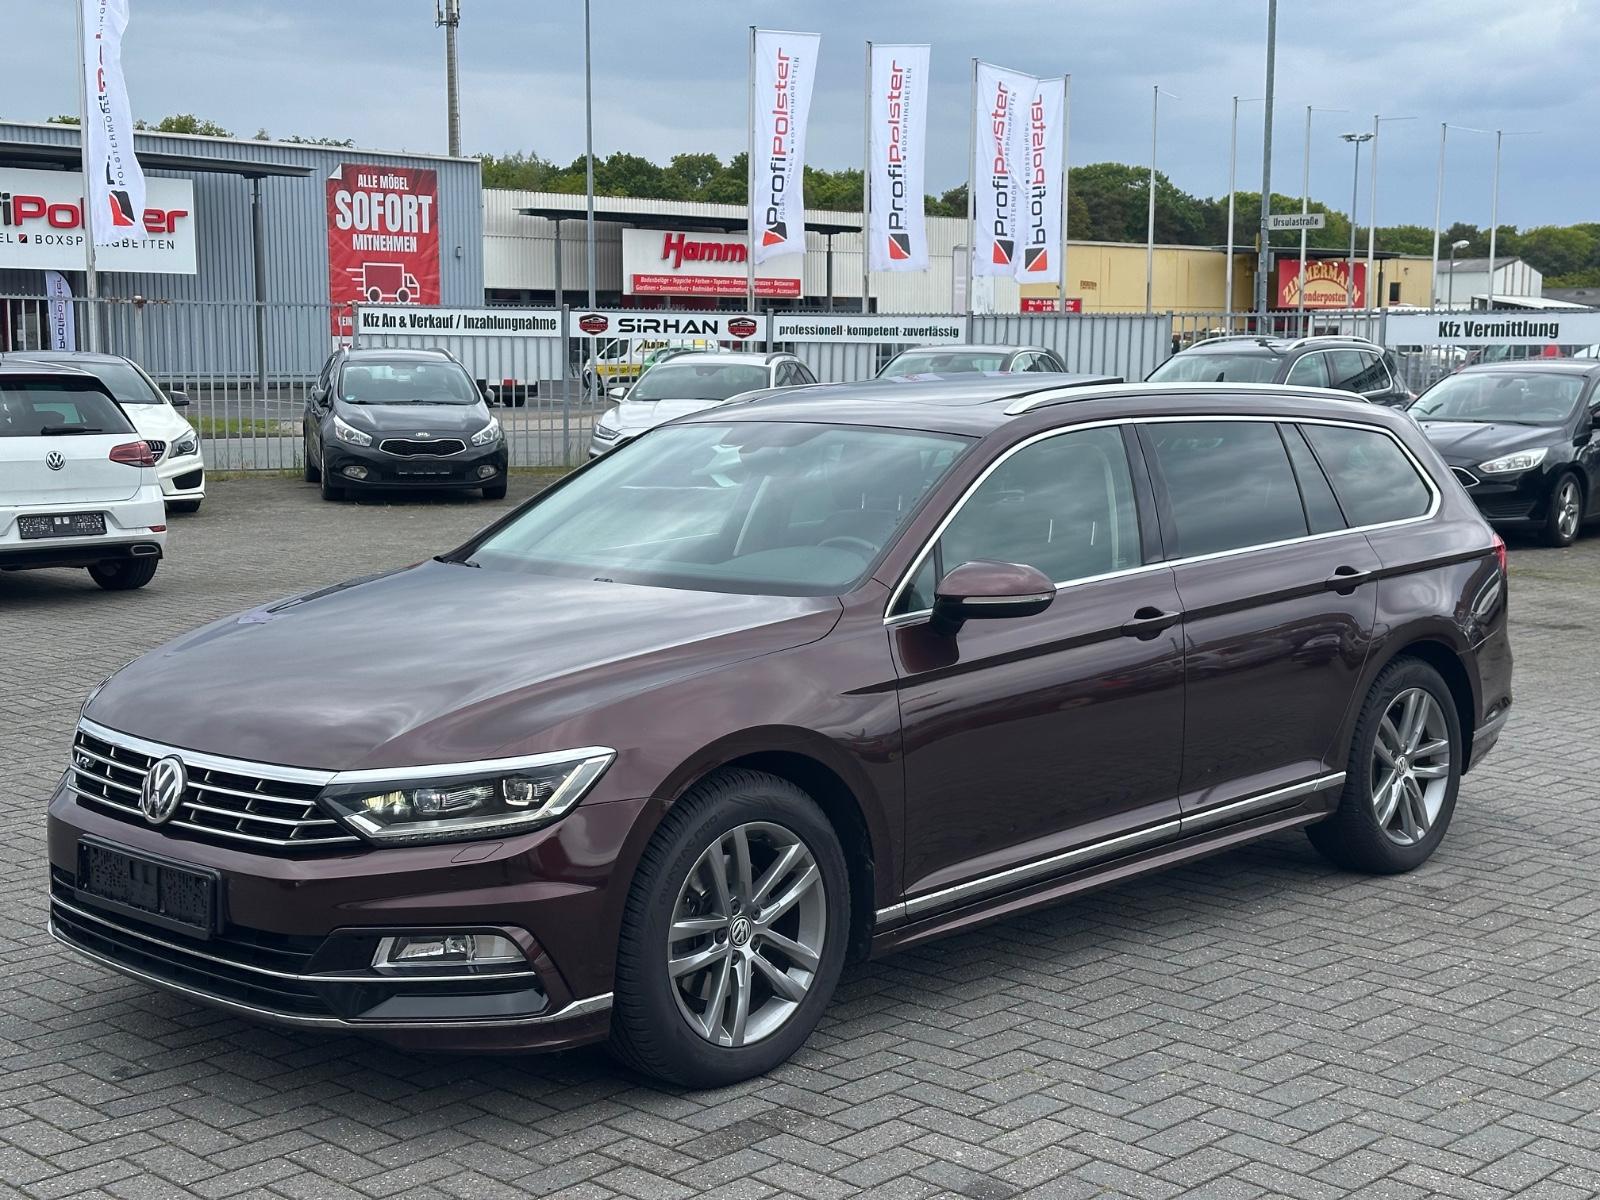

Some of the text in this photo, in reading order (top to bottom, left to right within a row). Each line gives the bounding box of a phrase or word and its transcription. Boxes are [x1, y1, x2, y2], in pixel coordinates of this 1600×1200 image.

[766, 47, 790, 226] ProfiPolster
[888, 59, 904, 230] ProfiPolster
[357, 174, 409, 190] ALLE MÖBEL
[334, 190, 432, 234] SOFORT
[1273, 216, 1319, 227] Ursulastraße
[352, 233, 417, 253] MITNEHMEN
[661, 232, 749, 269] Hamm
[1303, 289, 1346, 304] onderposten
[363, 313, 557, 331] Kfz An & Verkauf / Inzahlungnahme
[779, 324, 960, 338] professionell kompetent zuverlässig
[1438, 320, 1560, 339] Kfz Vermittlung
